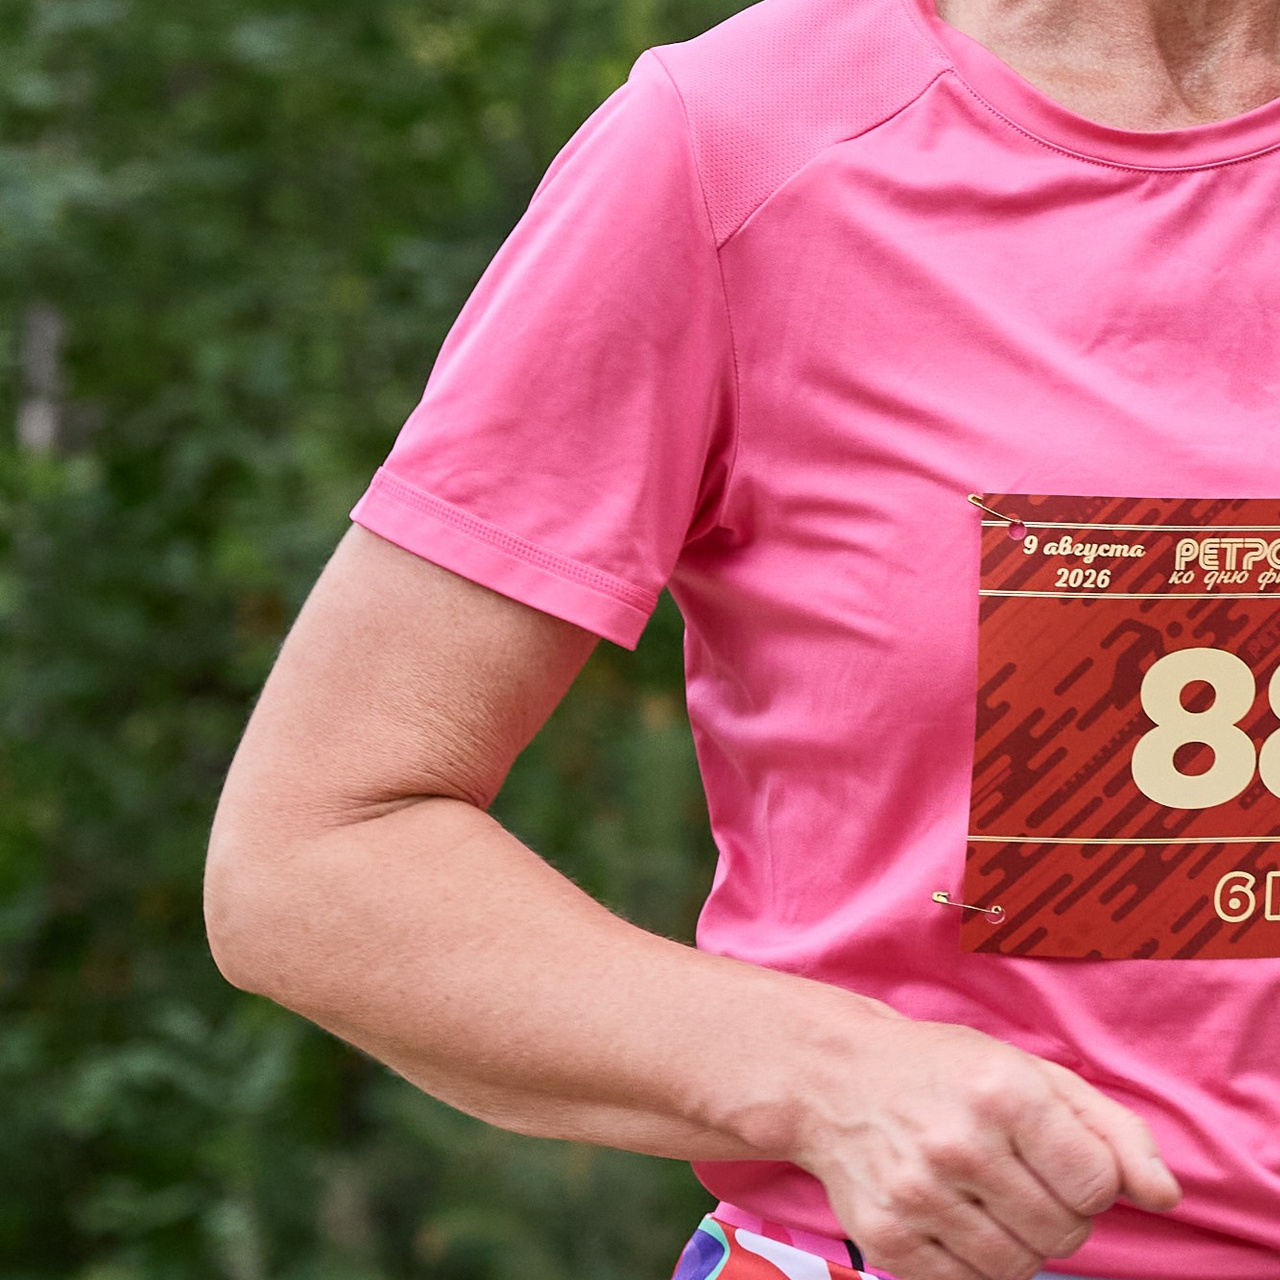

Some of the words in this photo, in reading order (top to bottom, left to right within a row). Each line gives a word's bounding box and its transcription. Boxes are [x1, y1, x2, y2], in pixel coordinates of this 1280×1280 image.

[1023, 535, 1038, 555] 9
[1043, 535, 1146, 564] августа
[1055, 568, 1112, 588] 2026
[1168, 570, 1195, 584] ко
[1203, 570, 1249, 591] дню
[1213, 871, 1256, 923] 6
